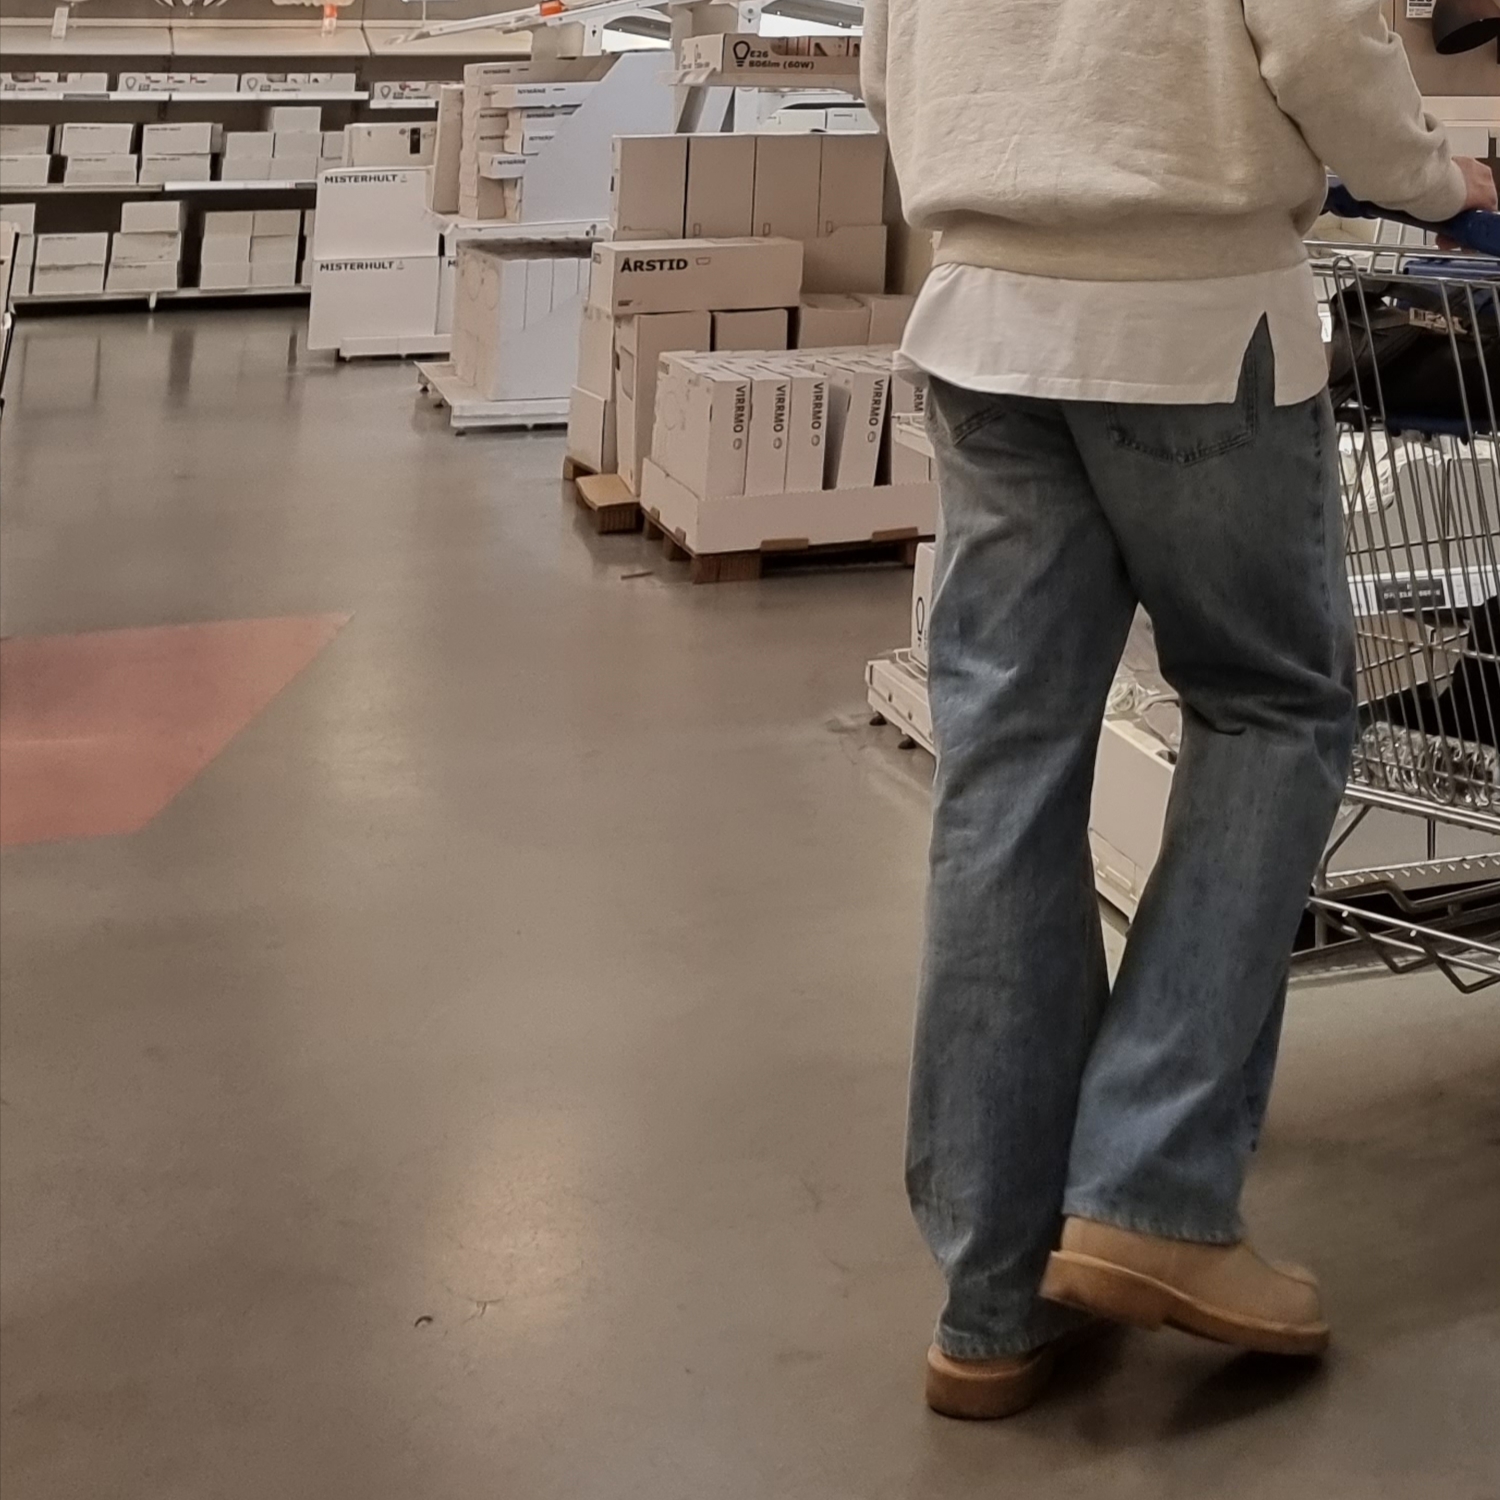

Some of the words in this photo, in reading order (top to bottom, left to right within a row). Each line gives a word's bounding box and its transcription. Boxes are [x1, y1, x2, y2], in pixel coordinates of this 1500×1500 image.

[750, 50, 769, 58] E26
[783, 60, 815, 70] (60W)
[324, 174, 398, 184] MISTERHULT
[319, 260, 395, 272] MISTERHULT
[620, 257, 688, 273] ÅRSTID
[733, 385, 747, 434] VIRRMO
[773, 385, 787, 433] VIRRMO
[811, 382, 824, 430] VIRRMO
[868, 379, 884, 427] VIRRMO
